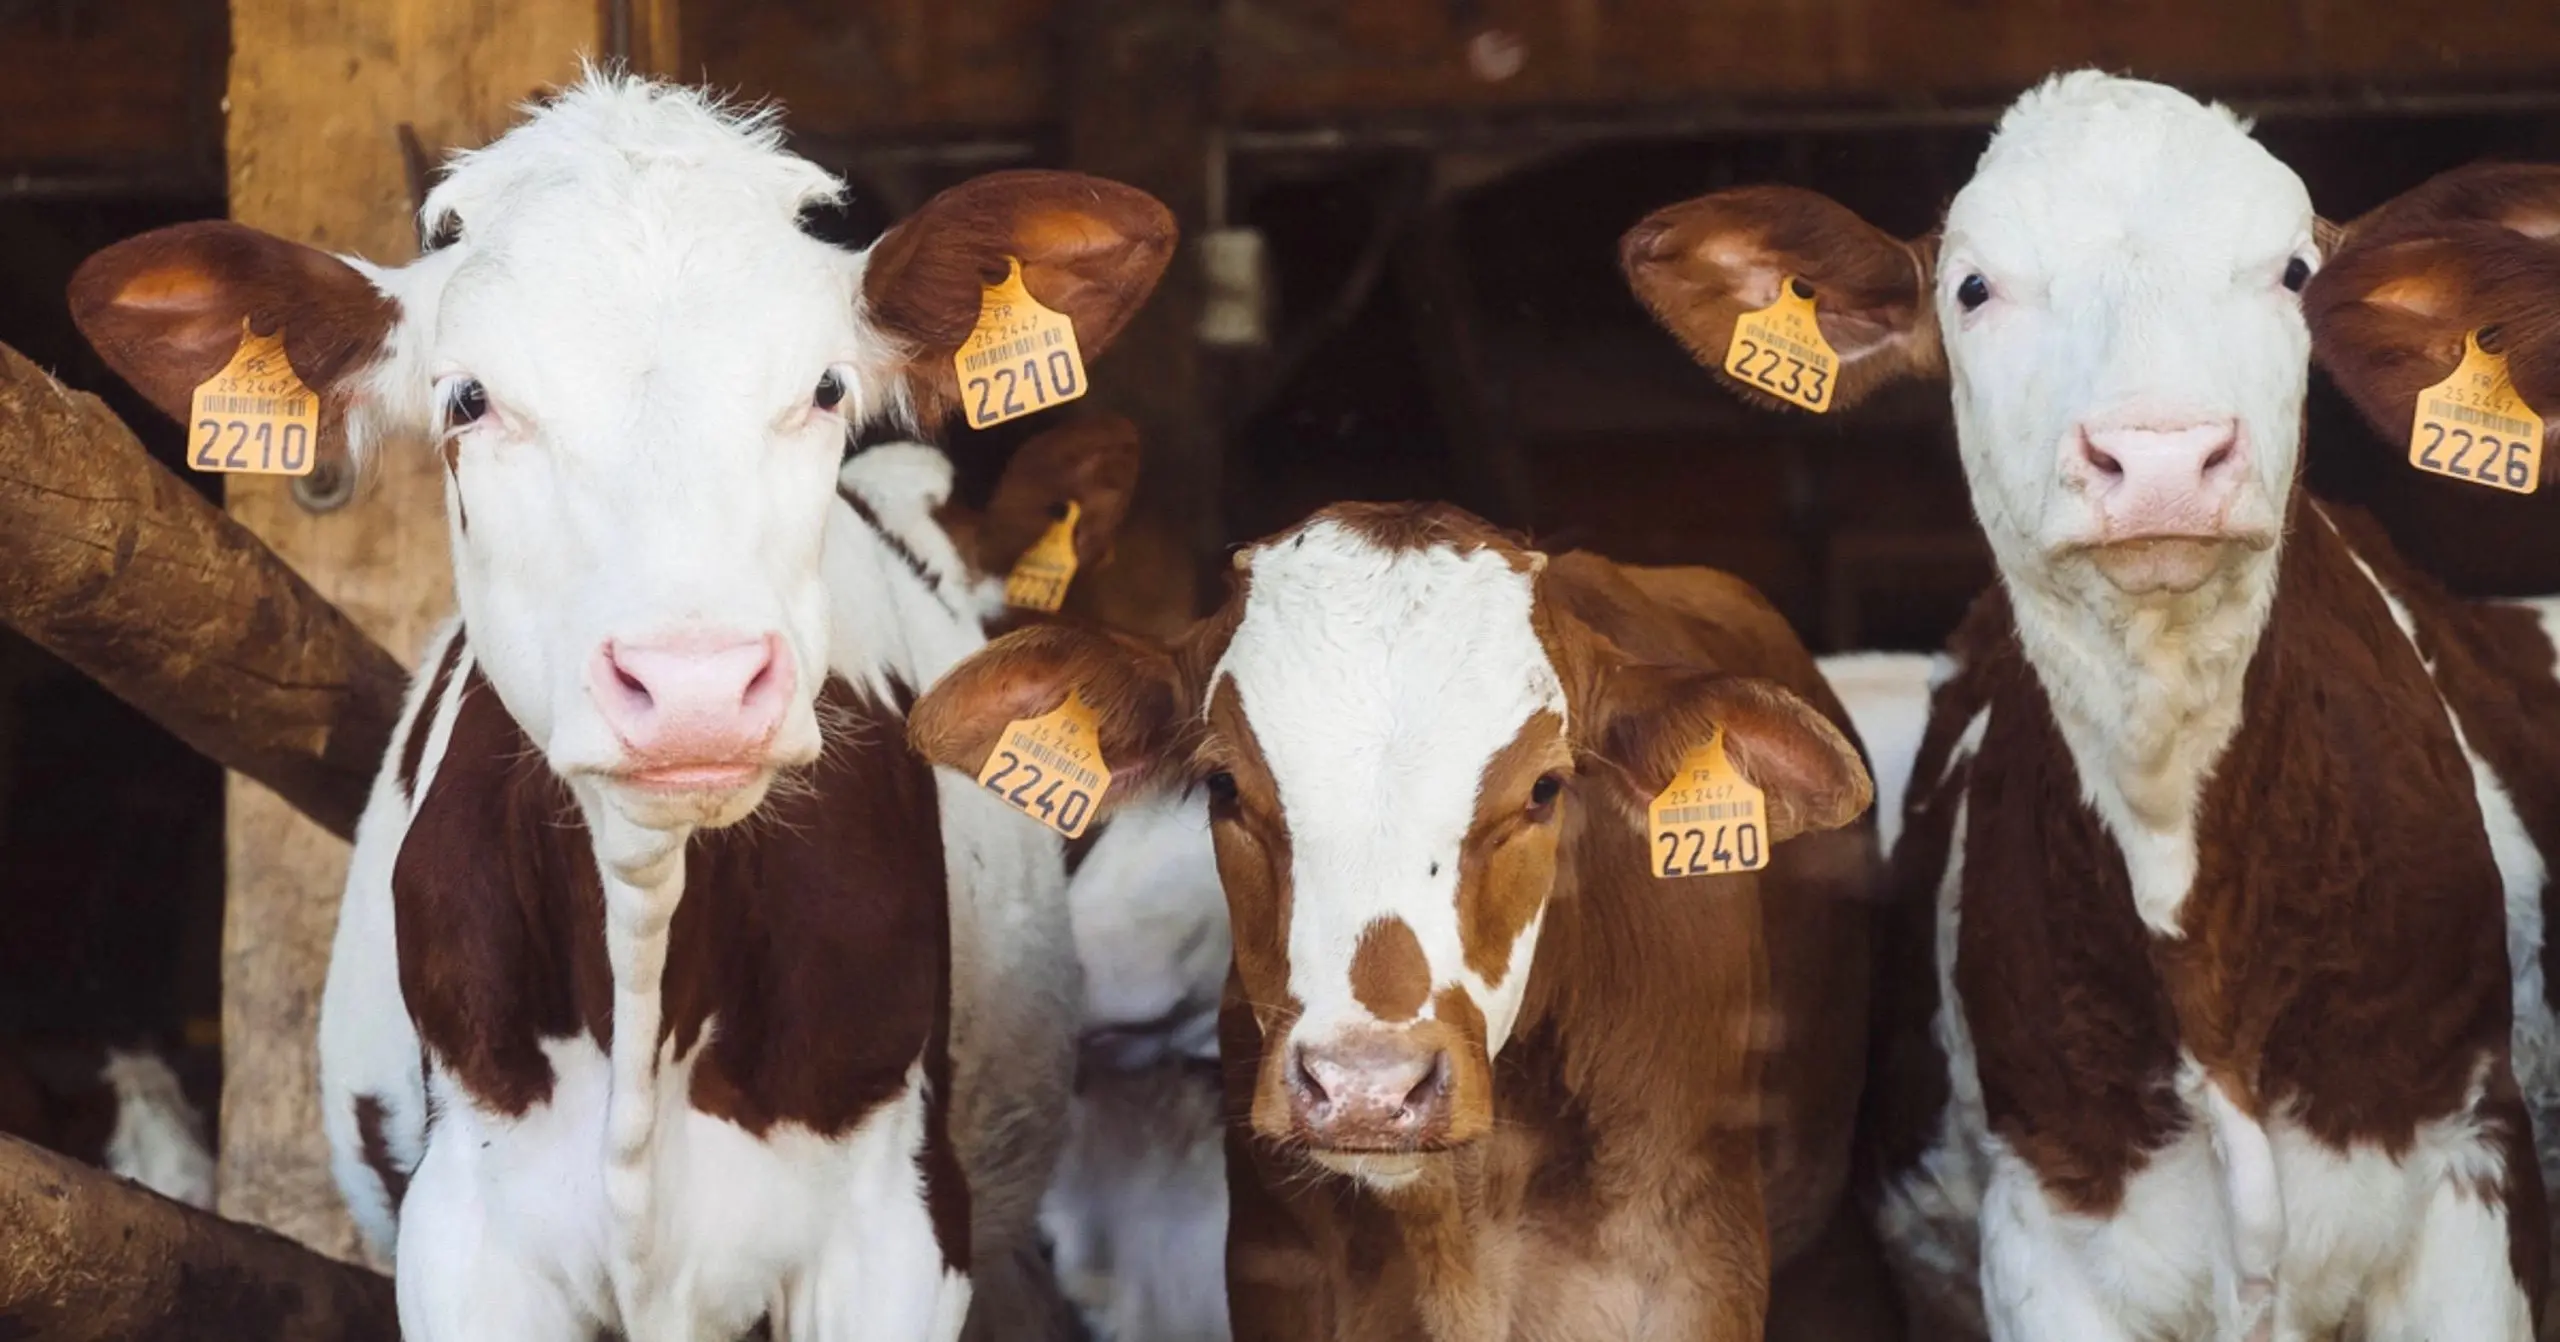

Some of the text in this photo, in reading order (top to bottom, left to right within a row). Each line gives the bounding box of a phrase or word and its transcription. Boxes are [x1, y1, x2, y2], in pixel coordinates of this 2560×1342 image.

[993, 305, 1012, 321] FR
[968, 350, 1076, 424] 2210
[1734, 340, 1828, 403] 2233
[2444, 386, 2464, 402] 25
[2472, 373, 2492, 389] FR
[196, 418, 307, 470] 2210
[2420, 422, 2531, 488] 2226
[986, 751, 1090, 832] 2240
[1671, 791, 1688, 805] 25
[1659, 823, 1759, 875] 2240
